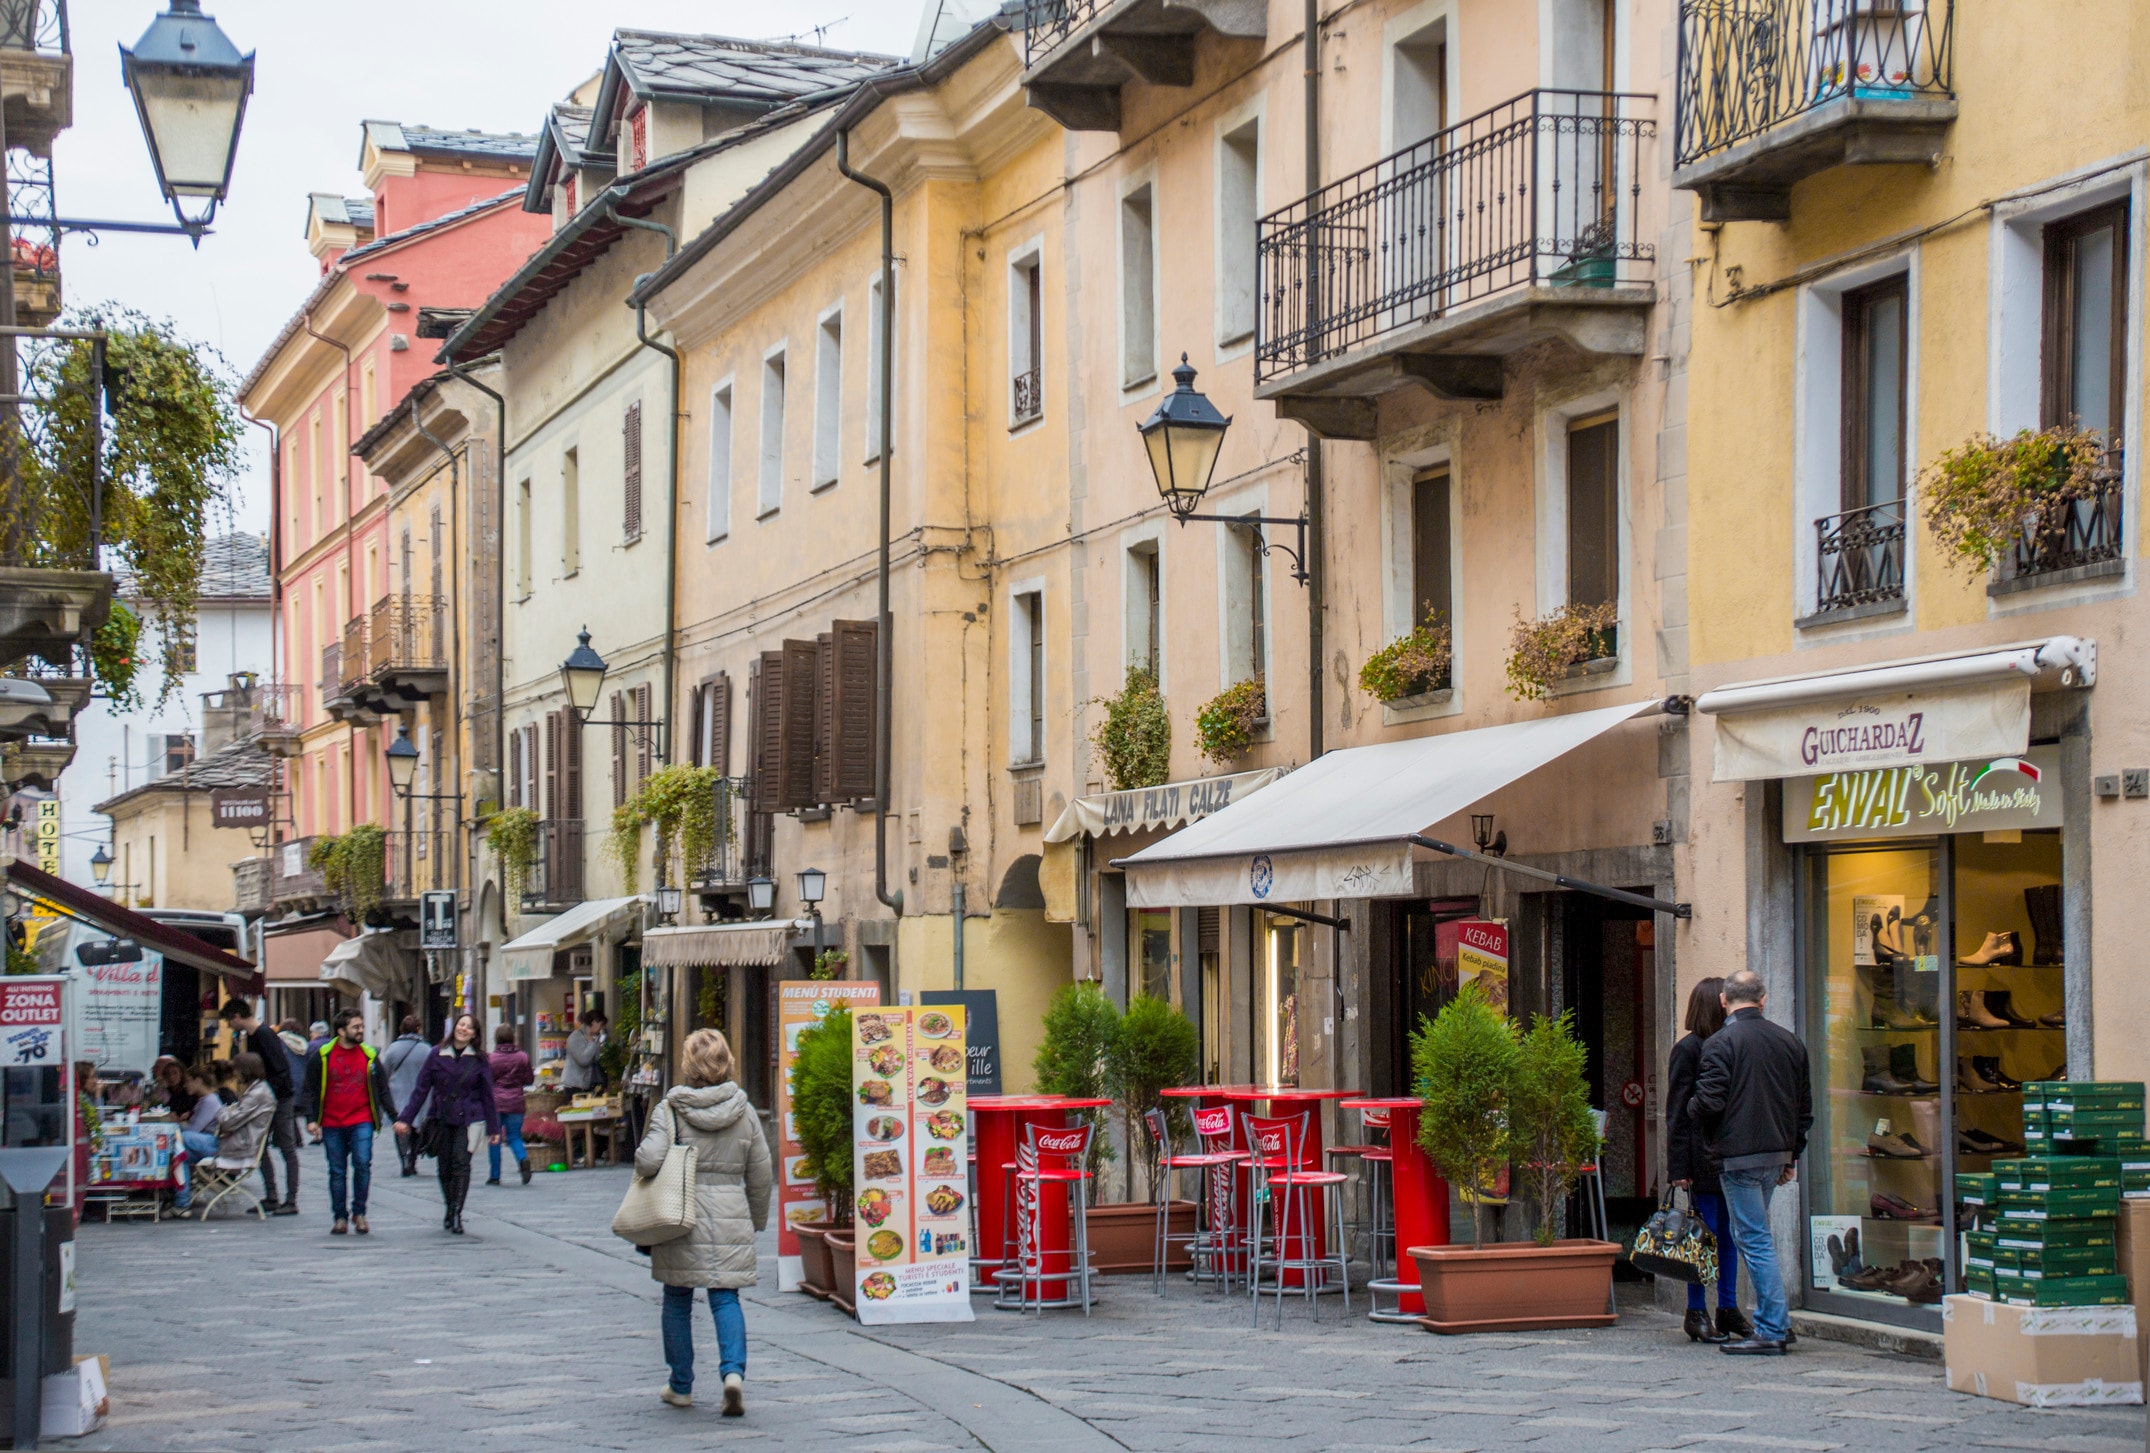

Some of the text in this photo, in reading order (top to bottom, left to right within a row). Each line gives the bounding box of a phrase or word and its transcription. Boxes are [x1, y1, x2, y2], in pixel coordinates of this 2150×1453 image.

[1801, 712, 1925, 766] GUICHARDAZ
[1103, 779, 1233, 826] LANA FILATI CALZE
[1918, 761, 1971, 829] Soft
[1970, 788, 1999, 813] Made
[2001, 793, 2013, 808] in
[2013, 787, 2041, 816] Italy
[220, 805, 264, 818] 11100
[428, 895, 451, 930] T
[1465, 927, 1502, 951] KEBAB
[1462, 953, 1506, 974] Kebab piadina
[5, 993, 56, 1007] ZONA
[782, 985, 878, 998] MENÚ STUDENTI
[1, 1008, 60, 1022] OUTLET
[1039, 1133, 1083, 1150] Coca-Cola
[899, 1273, 924, 1281] TURISTI
[931, 1268, 964, 1278] STUDENTI
[926, 1262, 956, 1271] SPECIALE
